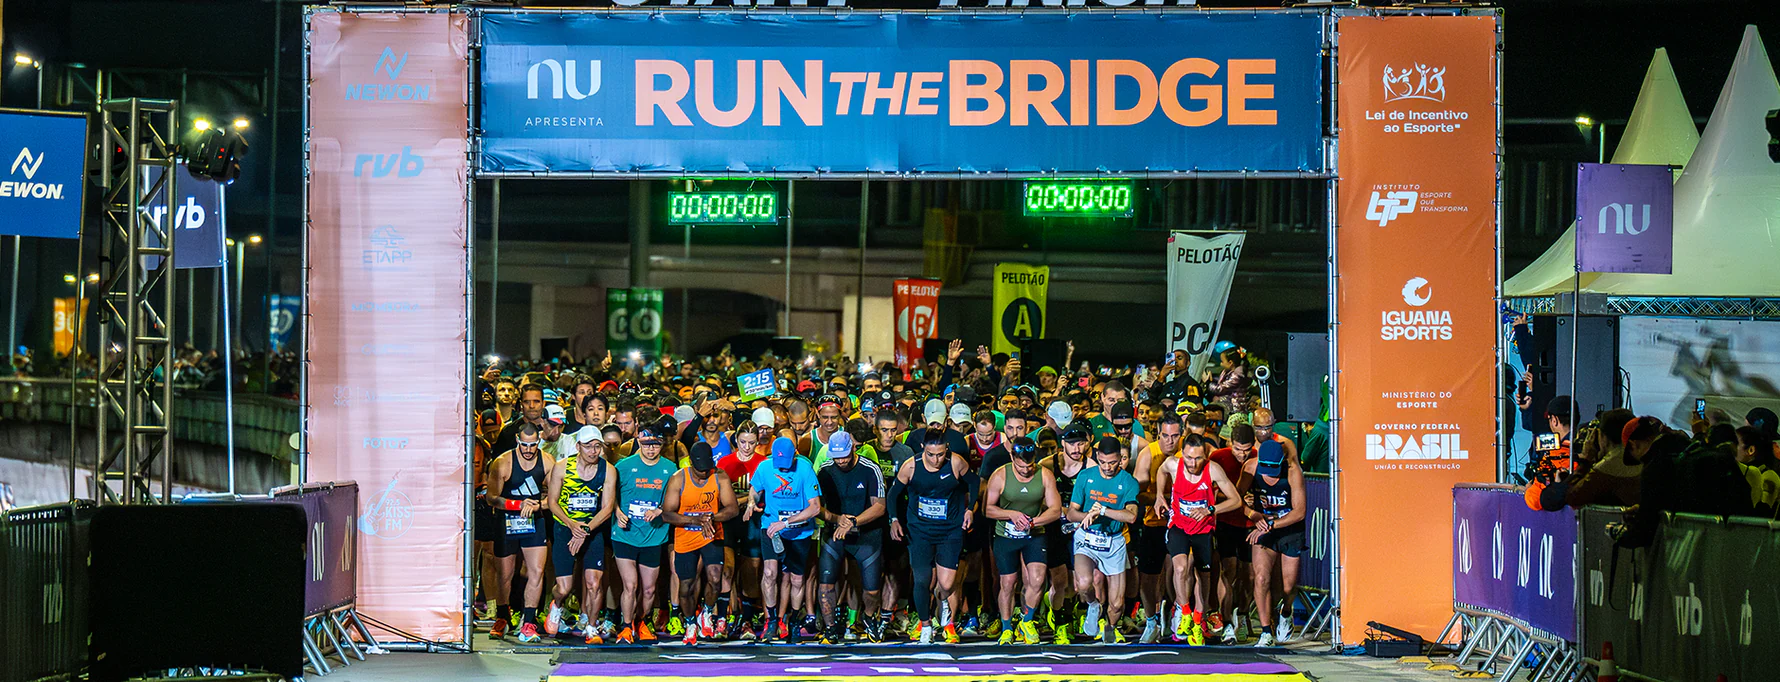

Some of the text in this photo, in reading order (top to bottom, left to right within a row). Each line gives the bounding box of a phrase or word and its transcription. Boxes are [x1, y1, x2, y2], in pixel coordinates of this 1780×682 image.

[345, 84, 430, 100] NEWON
[635, 57, 1277, 127] RUN THE BRIDGE
[525, 117, 604, 126] APRESENTA
[1365, 110, 1469, 120] Lei de Incentivo
[1384, 124, 1400, 133] ao
[1027, 185, 1129, 209] 00:00:00
[671, 194, 773, 218] 00:00:00
[1001, 272, 1045, 286] PELOTÃO
[1013, 305, 1032, 337] A
[1381, 311, 1453, 325] IGUANA
[1380, 326, 1453, 340] SPORTS
[743, 371, 770, 389] 2:15
[1365, 433, 1469, 460] BRASIL
[385, 506, 411, 518] KISS
[385, 519, 402, 530] FM
